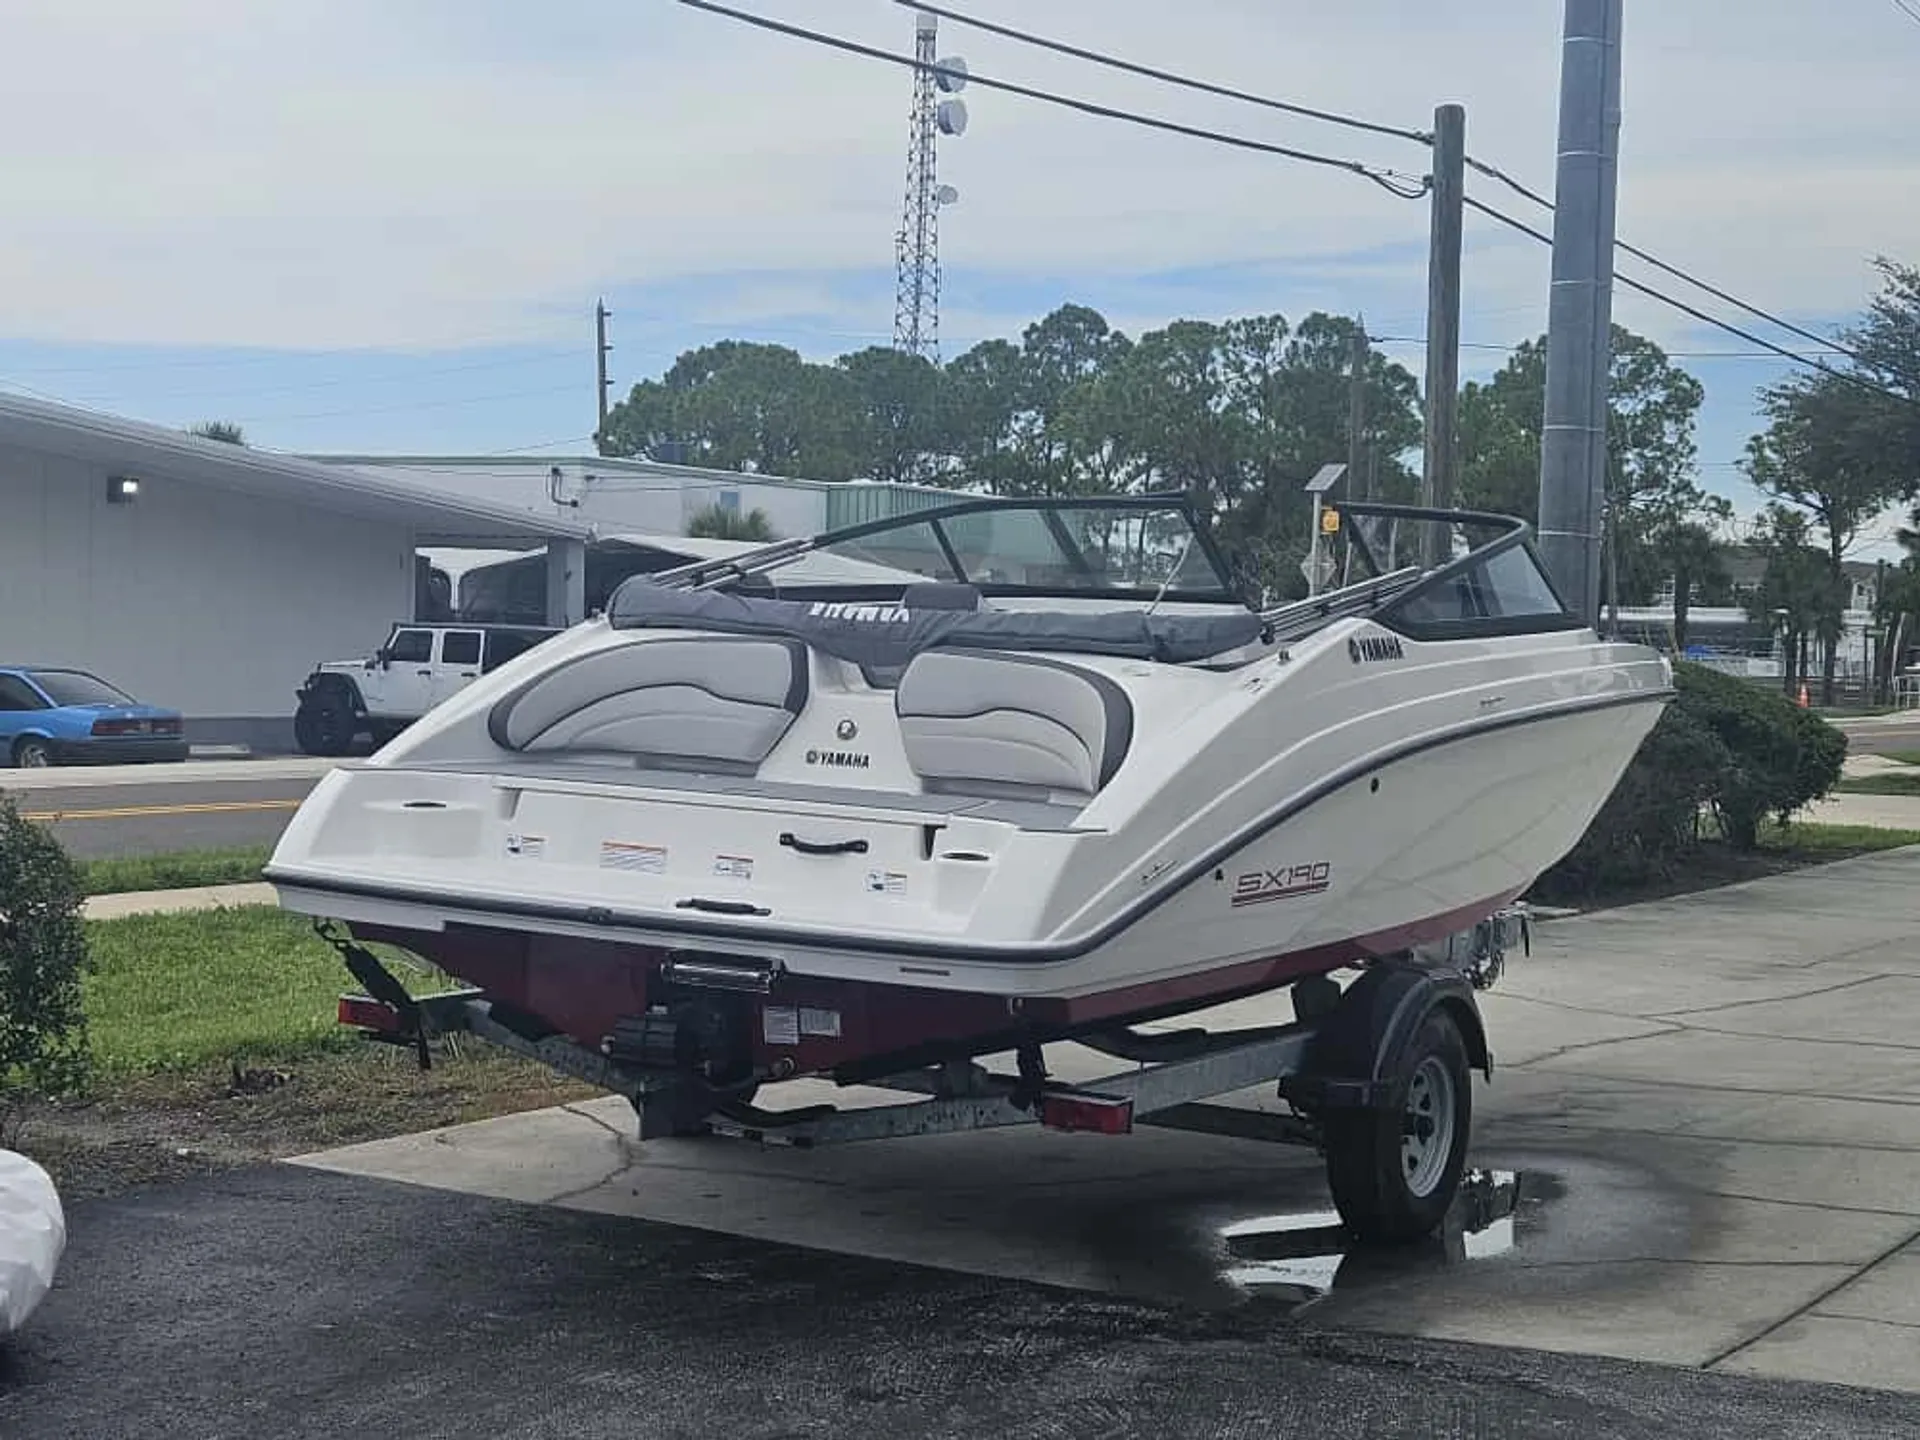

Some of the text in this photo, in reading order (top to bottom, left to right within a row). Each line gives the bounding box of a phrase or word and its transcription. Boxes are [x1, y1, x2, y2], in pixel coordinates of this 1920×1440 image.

[1359, 636, 1404, 662] YAMAHA
[820, 752, 869, 769] YAMAHA
[1237, 861, 1331, 893] SX190
